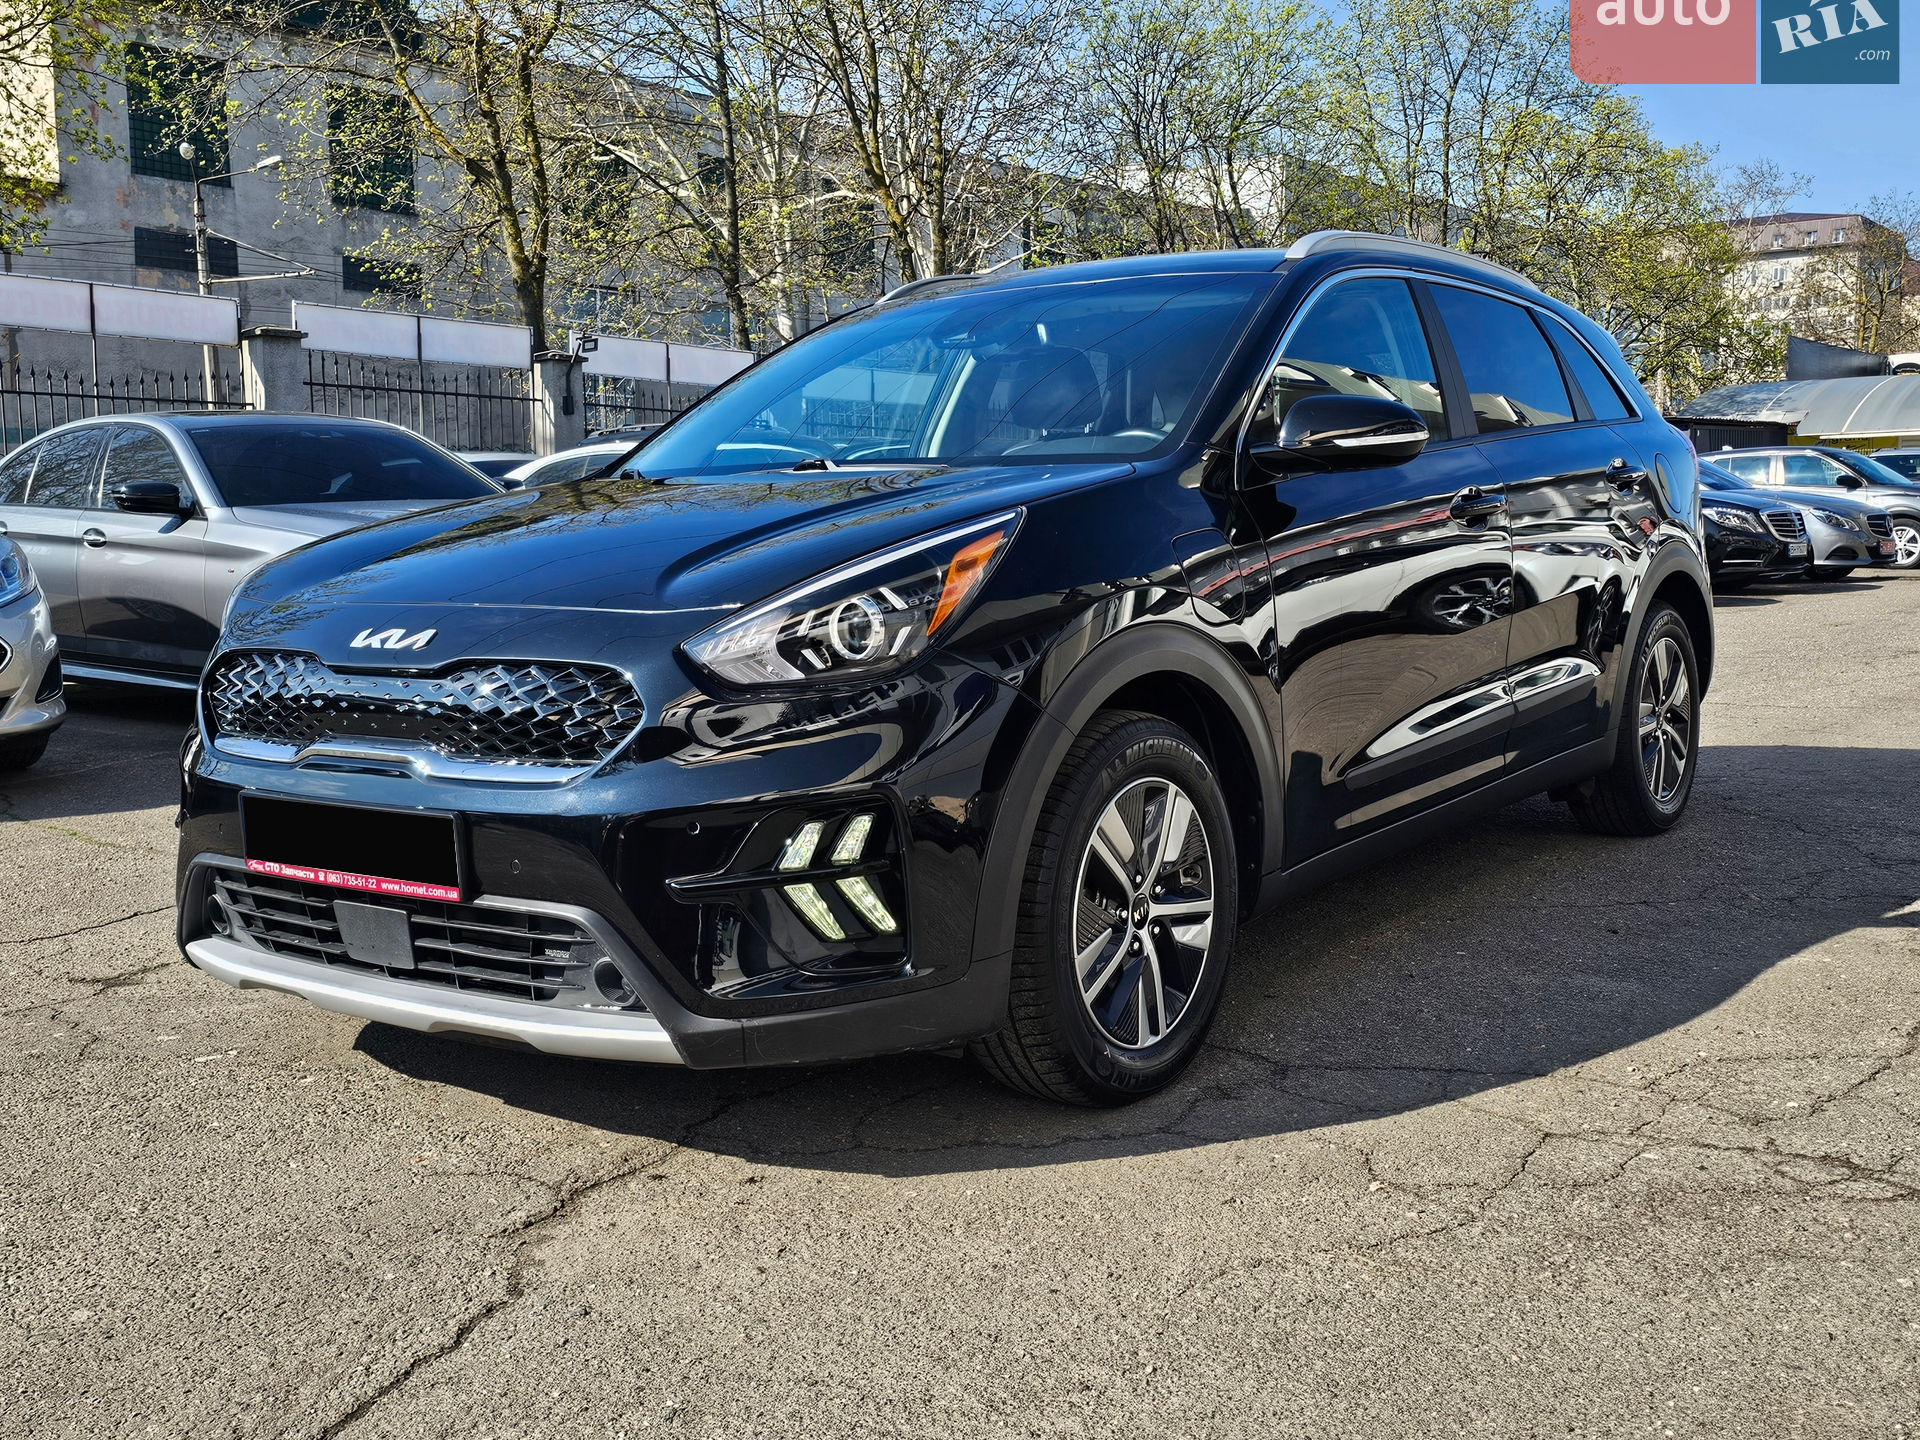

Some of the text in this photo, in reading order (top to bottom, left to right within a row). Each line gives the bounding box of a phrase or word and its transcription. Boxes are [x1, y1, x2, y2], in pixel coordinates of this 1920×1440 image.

[349, 627, 438, 651] KIA
[1125, 738, 1195, 769] MICHELIN
[264, 861, 280, 873] СТО
[280, 864, 315, 879] Запчасти
[326, 871, 343, 884] (063)
[343, 875, 377, 889] 735-51-22
